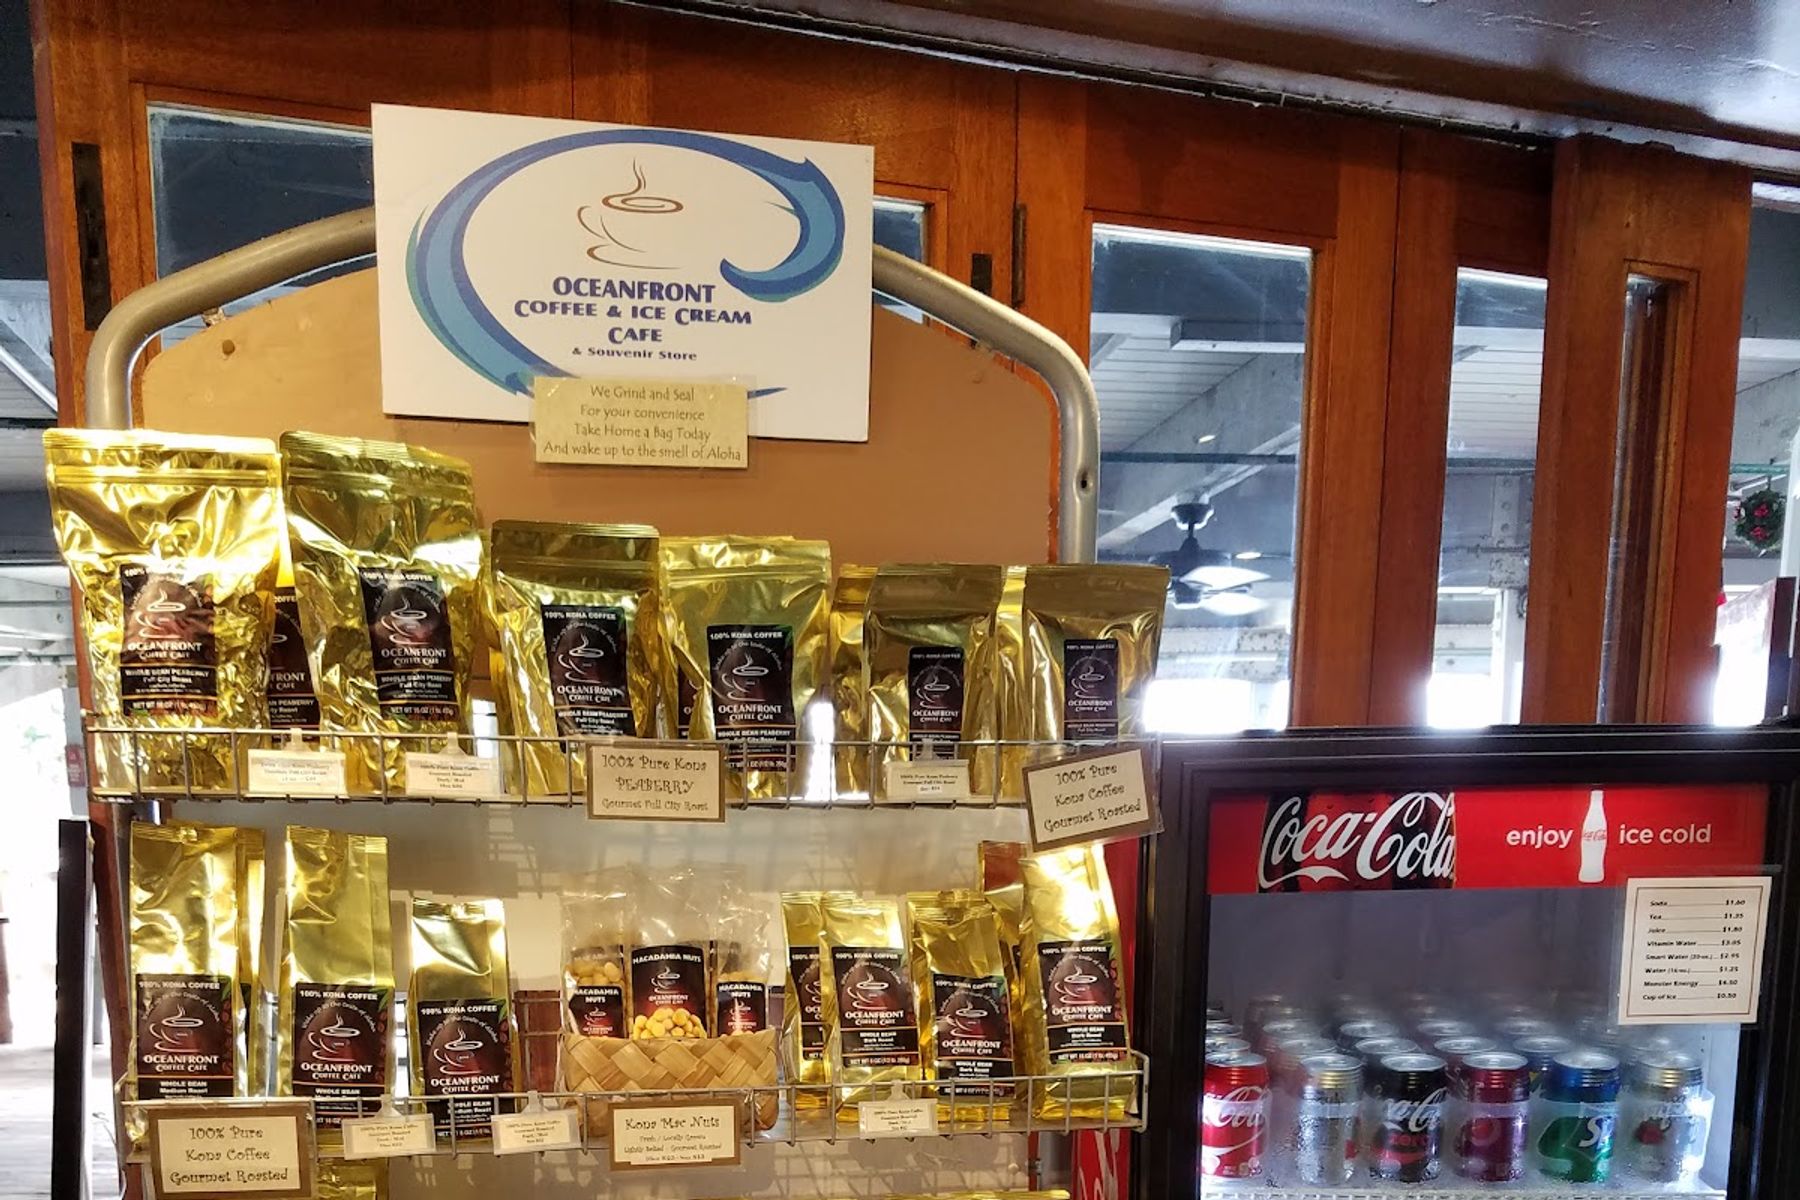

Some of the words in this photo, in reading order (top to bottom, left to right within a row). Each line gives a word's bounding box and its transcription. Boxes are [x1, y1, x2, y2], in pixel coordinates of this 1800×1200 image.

[553, 277, 716, 303] OCEANFRONT
[514, 300, 597, 317] COFFEE
[606, 305, 621, 317] &
[631, 306, 665, 320] ICE
[675, 307, 751, 325] CREAM
[608, 327, 662, 344] CAFE
[572, 347, 582, 355] &
[588, 347, 652, 359] Souvenir
[659, 351, 697, 360] Store
[590, 385, 611, 398] We
[613, 386, 646, 400] Grind
[649, 386, 669, 400] and
[673, 387, 695, 400] Seal
[580, 404, 600, 416] For
[603, 406, 630, 420] your
[634, 408, 705, 421] convenience
[574, 423, 600, 436] Take
[604, 424, 640, 437] Home
[643, 429, 650, 438] a
[653, 427, 672, 442] Bag
[676, 428, 711, 443] Today
[543, 441, 568, 455] And
[572, 442, 600, 456] wake
[604, 446, 618, 459] up
[622, 444, 633, 456] to
[638, 445, 659, 458] the
[658, 445, 688, 459] smell
[691, 446, 707, 460] of
[706, 447, 741, 461] Aloha
[381, 647, 446, 658] OCEANFRONT
[557, 685, 618, 696] OCEANFRONT
[718, 704, 782, 714] OCEANFRONT
[601, 754, 635, 768] 100%
[639, 754, 670, 769] Pure
[674, 757, 707, 771] Kona
[1055, 767, 1086, 786] 100%
[1089, 763, 1118, 778] Pure
[615, 776, 694, 794] PEABERRY
[1055, 792, 1085, 807] Kona
[1088, 783, 1125, 800] Coffee
[601, 798, 642, 809] Gourmet
[1044, 812, 1095, 833] Gourmet
[1097, 798, 1141, 821] Roasted
[1257, 791, 1455, 889] Coca-Cola
[1506, 827, 1573, 849] enjoy
[1619, 823, 1653, 844] ice
[1660, 823, 1712, 845] cold
[632, 953, 681, 964] MACADAMIA
[683, 953, 702, 964] NUTS
[300, 990, 321, 998] 100%
[323, 991, 345, 999] KONA
[348, 992, 378, 1000] COFFEE
[585, 996, 606, 1004] NUTS
[467, 1005, 497, 1013] COFFEE
[845, 1011, 904, 1019] OCEANFRONT
[1052, 1006, 1112, 1015] OCEANFRONT
[942, 1040, 1001, 1049] OCEANFRONT
[143, 1055, 219, 1064] OCEANFRONT
[301, 1062, 373, 1073] OCEANFRONT
[431, 1075, 500, 1087] OCEANFRONT
[625, 1119, 656, 1130] Kona
[661, 1117, 686, 1128] Mac
[690, 1116, 720, 1127] Nuts
[189, 1126, 224, 1140] 100%
[230, 1125, 263, 1139] Pure
[186, 1148, 221, 1161] Kona
[227, 1147, 270, 1161] Coffee
[170, 1171, 231, 1186] Gourmet
[236, 1168, 288, 1184] Roasted
